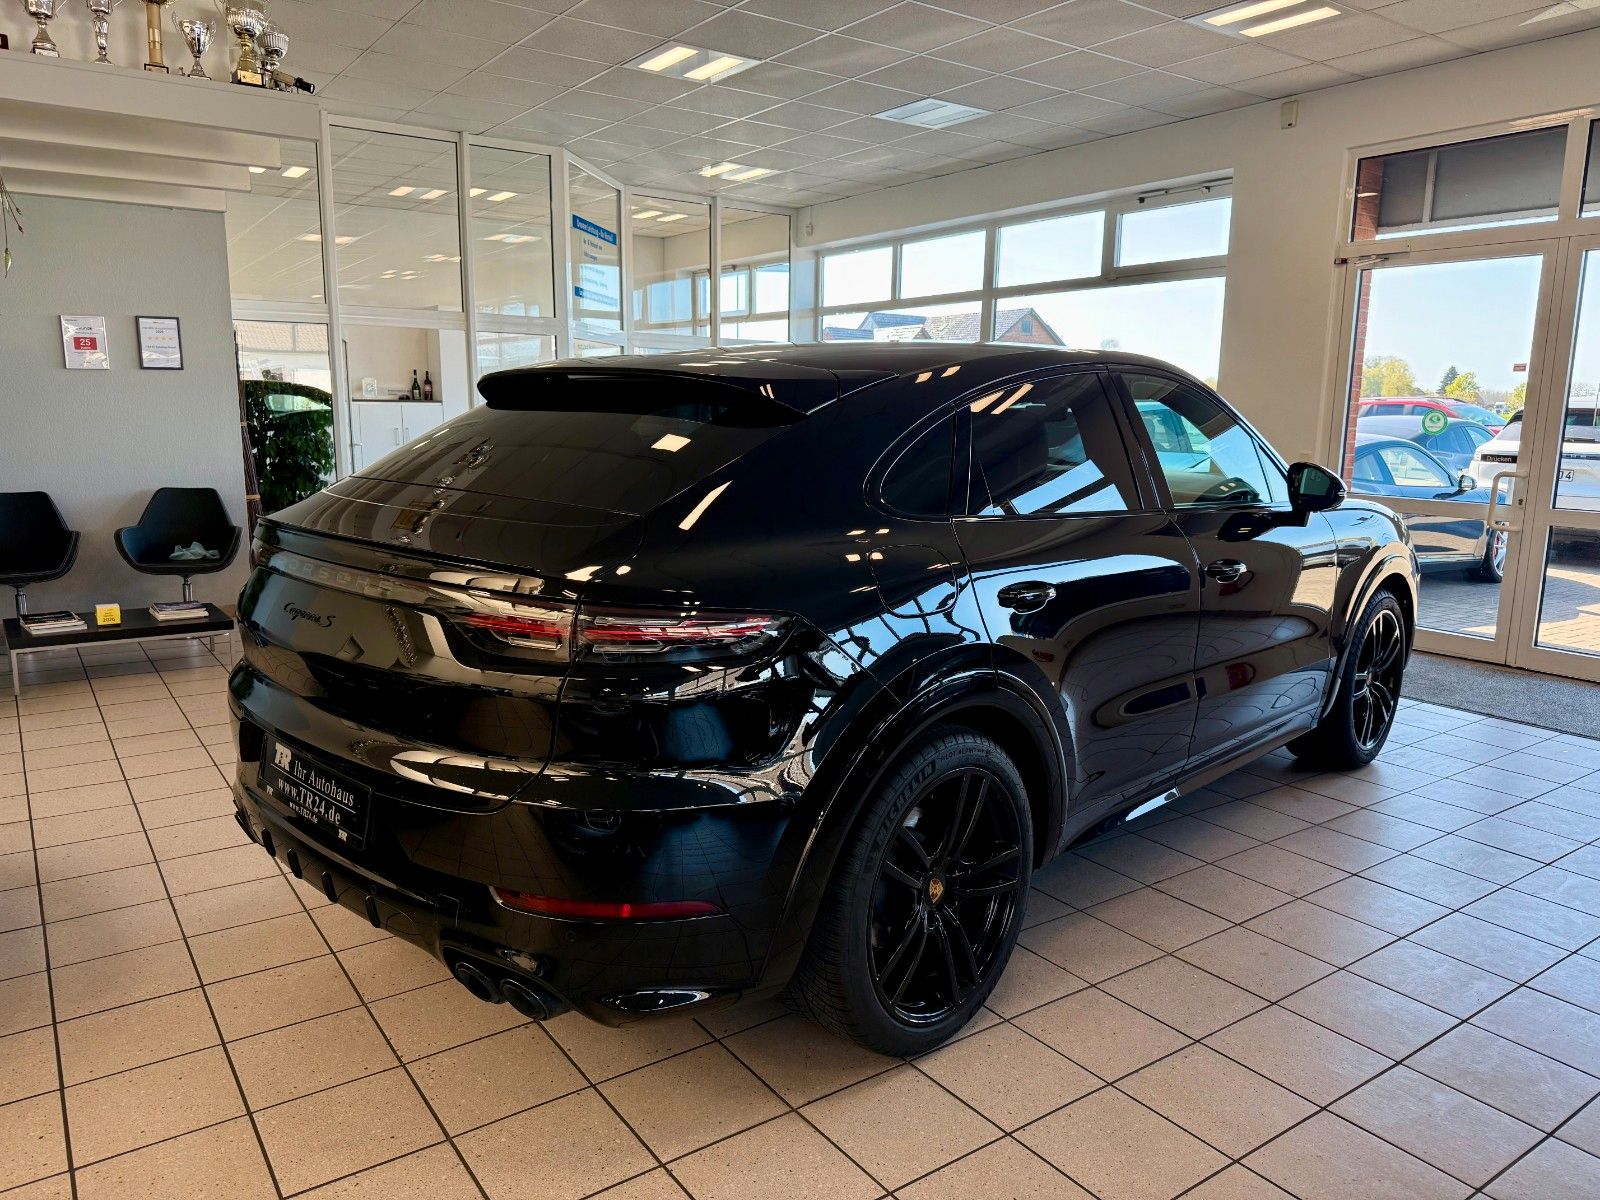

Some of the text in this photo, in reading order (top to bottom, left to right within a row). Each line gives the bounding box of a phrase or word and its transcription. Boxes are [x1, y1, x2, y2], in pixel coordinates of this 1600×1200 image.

[79, 338, 91, 346] 25
[1486, 455, 1512, 463] Drücken
[283, 602, 337, 628] Cayenne S
[294, 760, 355, 808] Ihr Autohaus
[278, 778, 341, 825] www.TR24.de
[289, 801, 319, 824] www.TR24.de
[876, 762, 933, 842] MICHELIN
